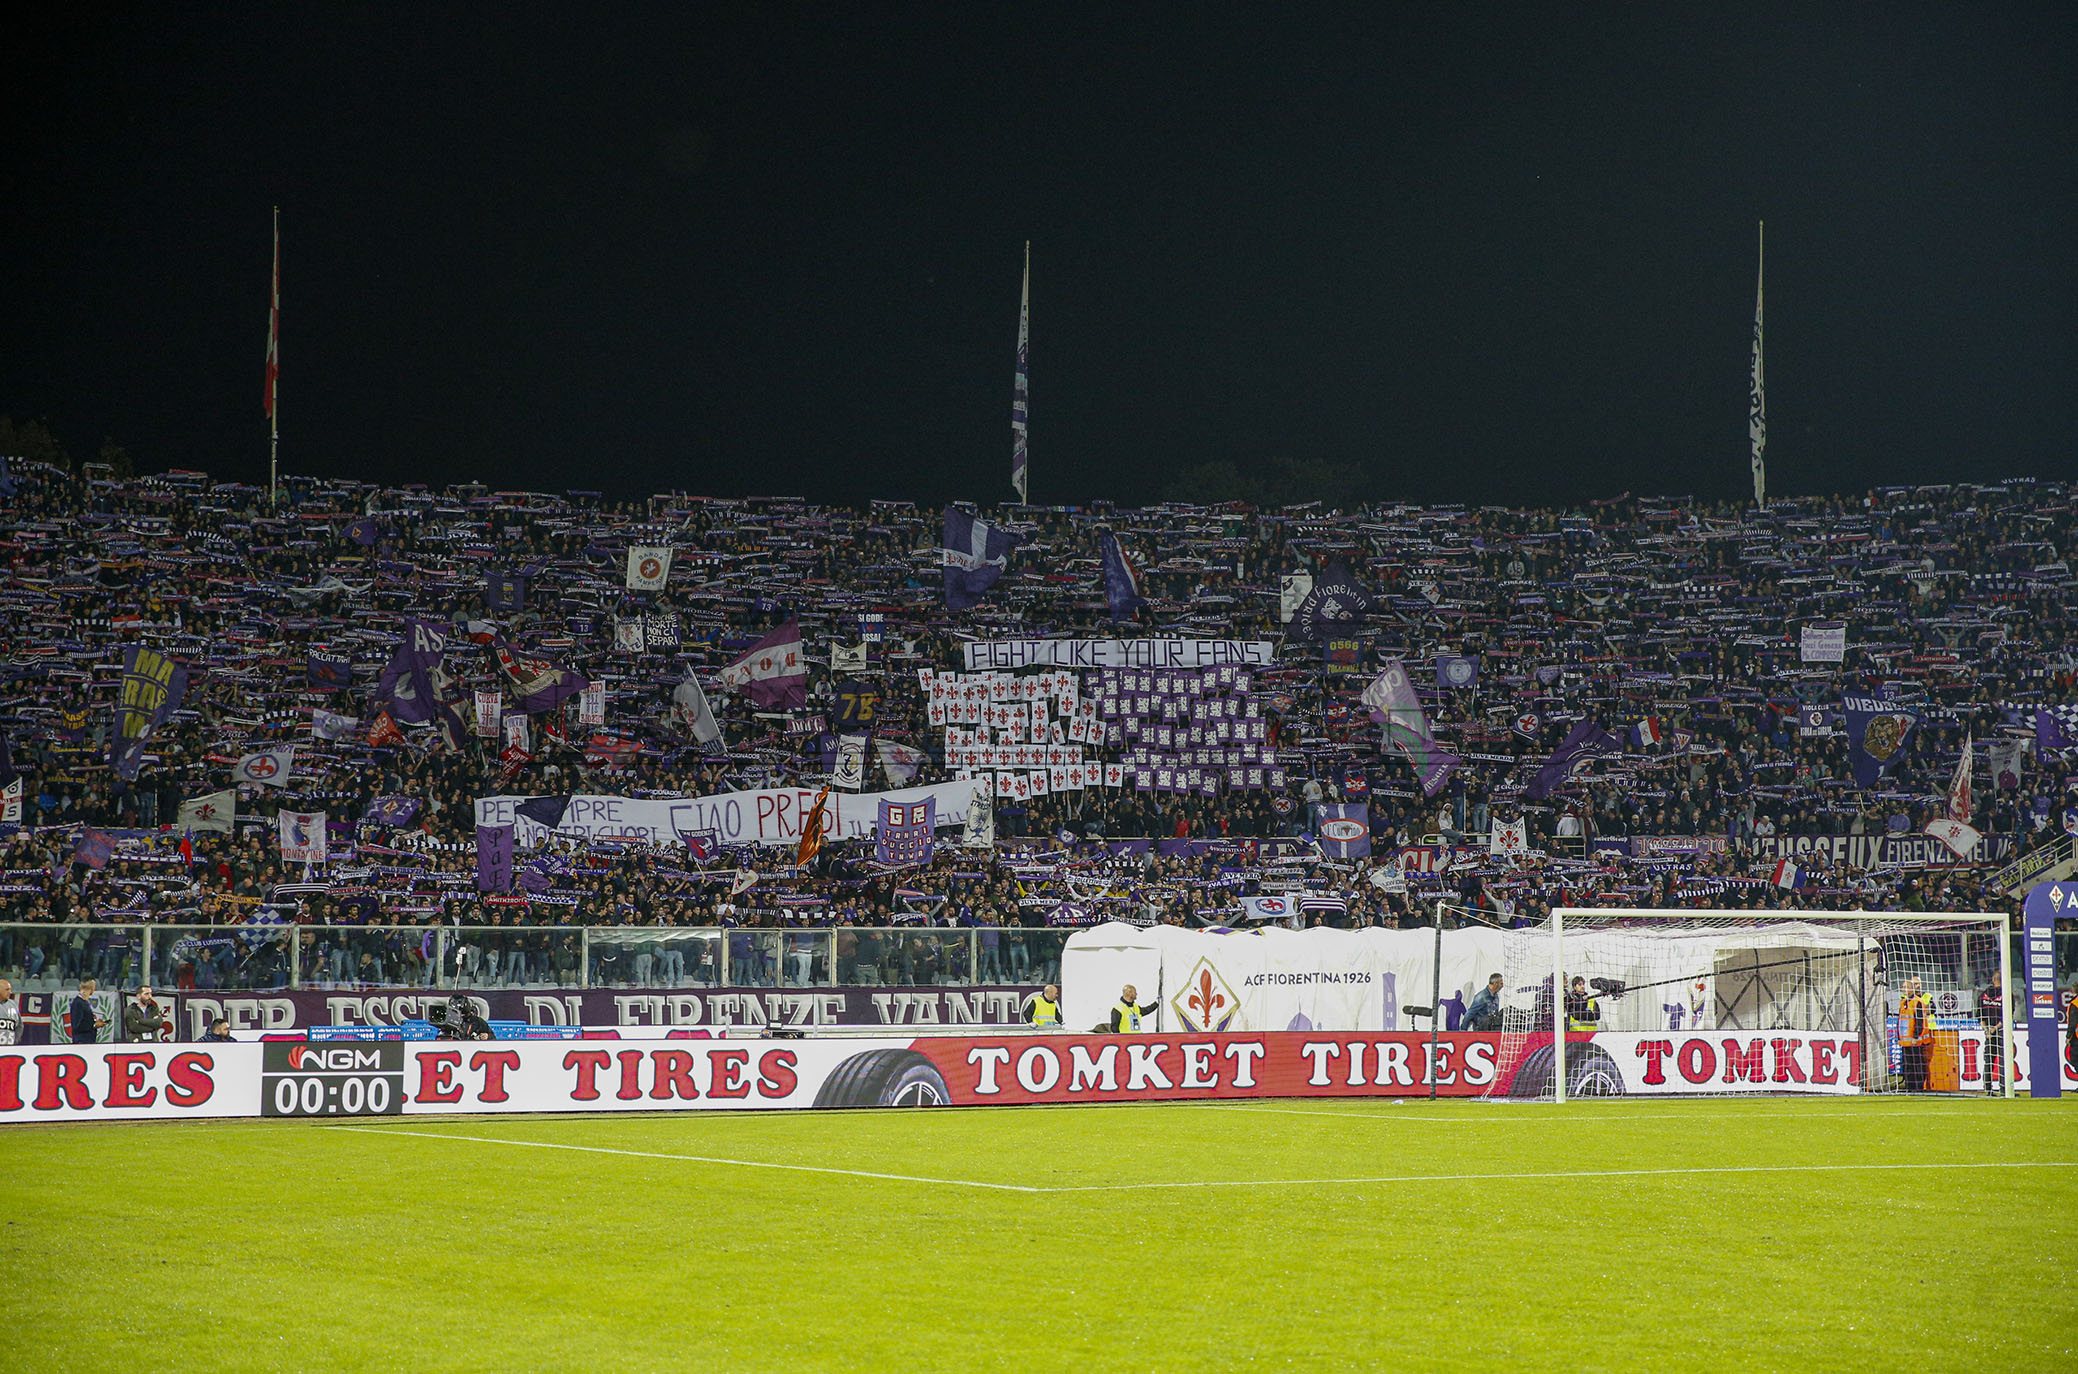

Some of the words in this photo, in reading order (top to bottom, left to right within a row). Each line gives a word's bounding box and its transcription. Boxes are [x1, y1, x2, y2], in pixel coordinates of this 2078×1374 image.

[649, 619, 678, 629] MORTE
[866, 613, 884, 623] GODE
[647, 634, 679, 647] SEPARI
[1329, 641, 1359, 651] 0566
[971, 641, 1041, 667] FIGHT
[1054, 641, 1107, 667] LIKE
[1120, 641, 1183, 667] YOUR
[1196, 641, 1261, 665] FANS
[133, 649, 175, 687] MA
[669, 799, 741, 842] CIAO
[882, 837, 932, 850] DUCCIO
[1652, 863, 1693, 871] ULTRAS
[1244, 973, 1265, 986] ACF
[1267, 972, 1342, 985] FIORENTINA
[1343, 971, 1371, 984] 1926
[614, 993, 846, 1026] FIRENZE
[300, 1047, 382, 1071] NGM
[967, 1040, 1266, 1096] TOMKET
[1301, 1039, 1497, 1088] TIRES
[1634, 1037, 1860, 1087] TOMKET
[403, 1050, 521, 1104] ET
[563, 1048, 799, 1101] TIRES
[274, 1076, 391, 1116] 00:00
